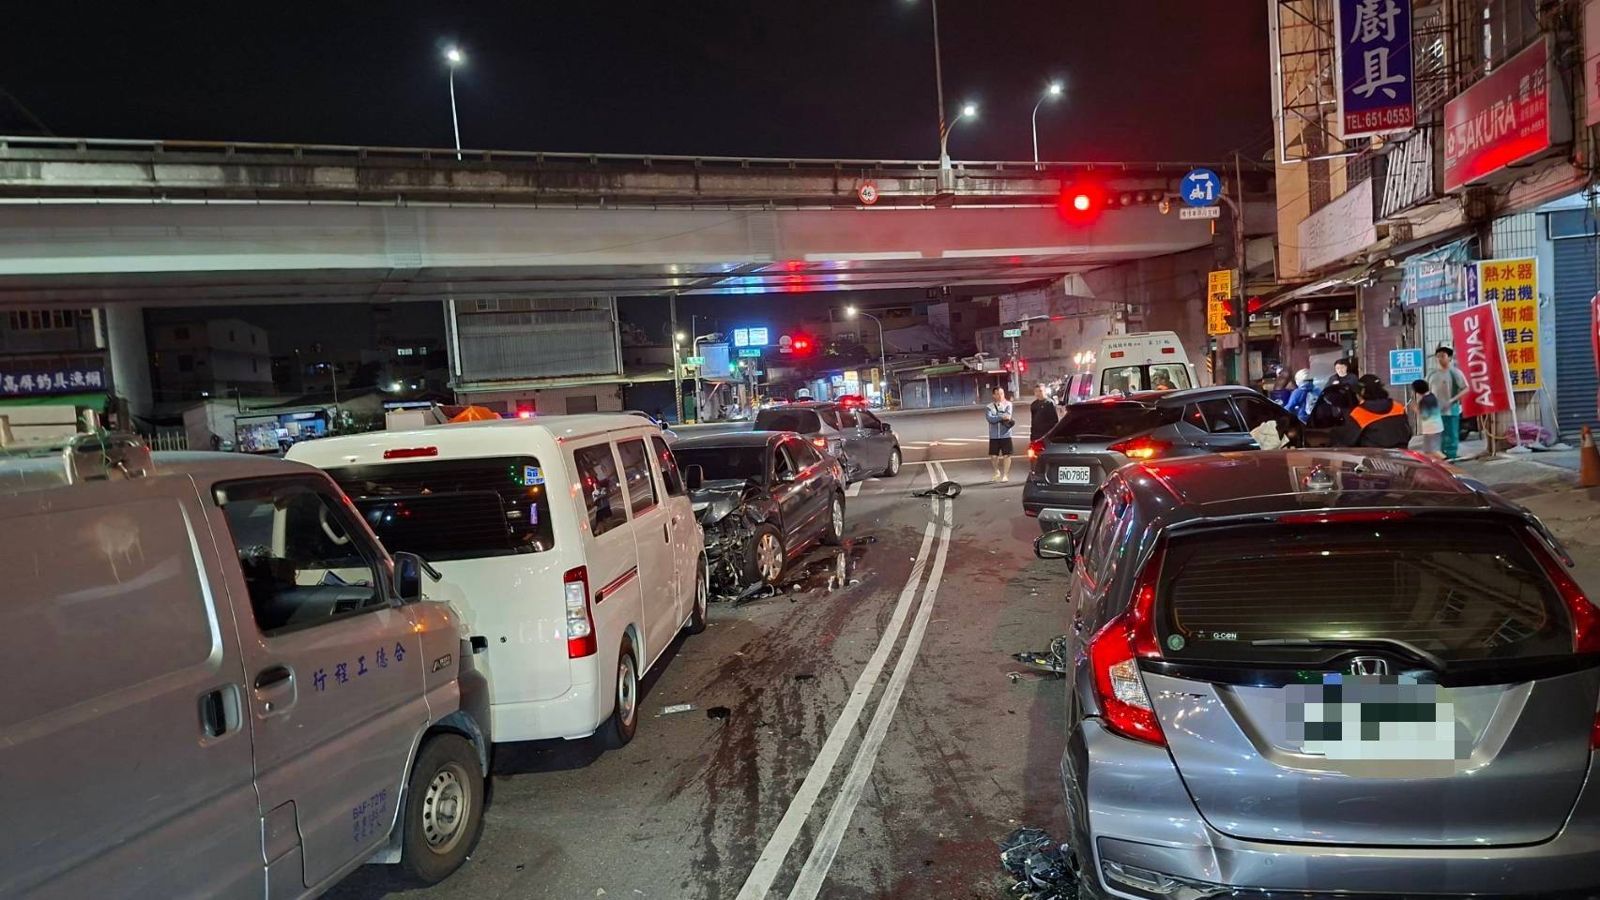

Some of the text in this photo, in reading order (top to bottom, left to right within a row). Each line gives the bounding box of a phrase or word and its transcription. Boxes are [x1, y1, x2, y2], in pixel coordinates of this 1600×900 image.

[1350, 0, 1406, 99] 廚具
[1347, 107, 1410, 130] TEL:651-0553
[1455, 94, 1516, 158] SAKURA
[1484, 263, 1533, 282] 熱水器
[1485, 284, 1533, 302] 排油機
[1498, 305, 1534, 323] 斯爐
[1503, 327, 1534, 344] 理台
[1397, 352, 1414, 368] 租
[1508, 347, 1535, 364] 統櫃
[1510, 368, 1536, 386] 器櫃
